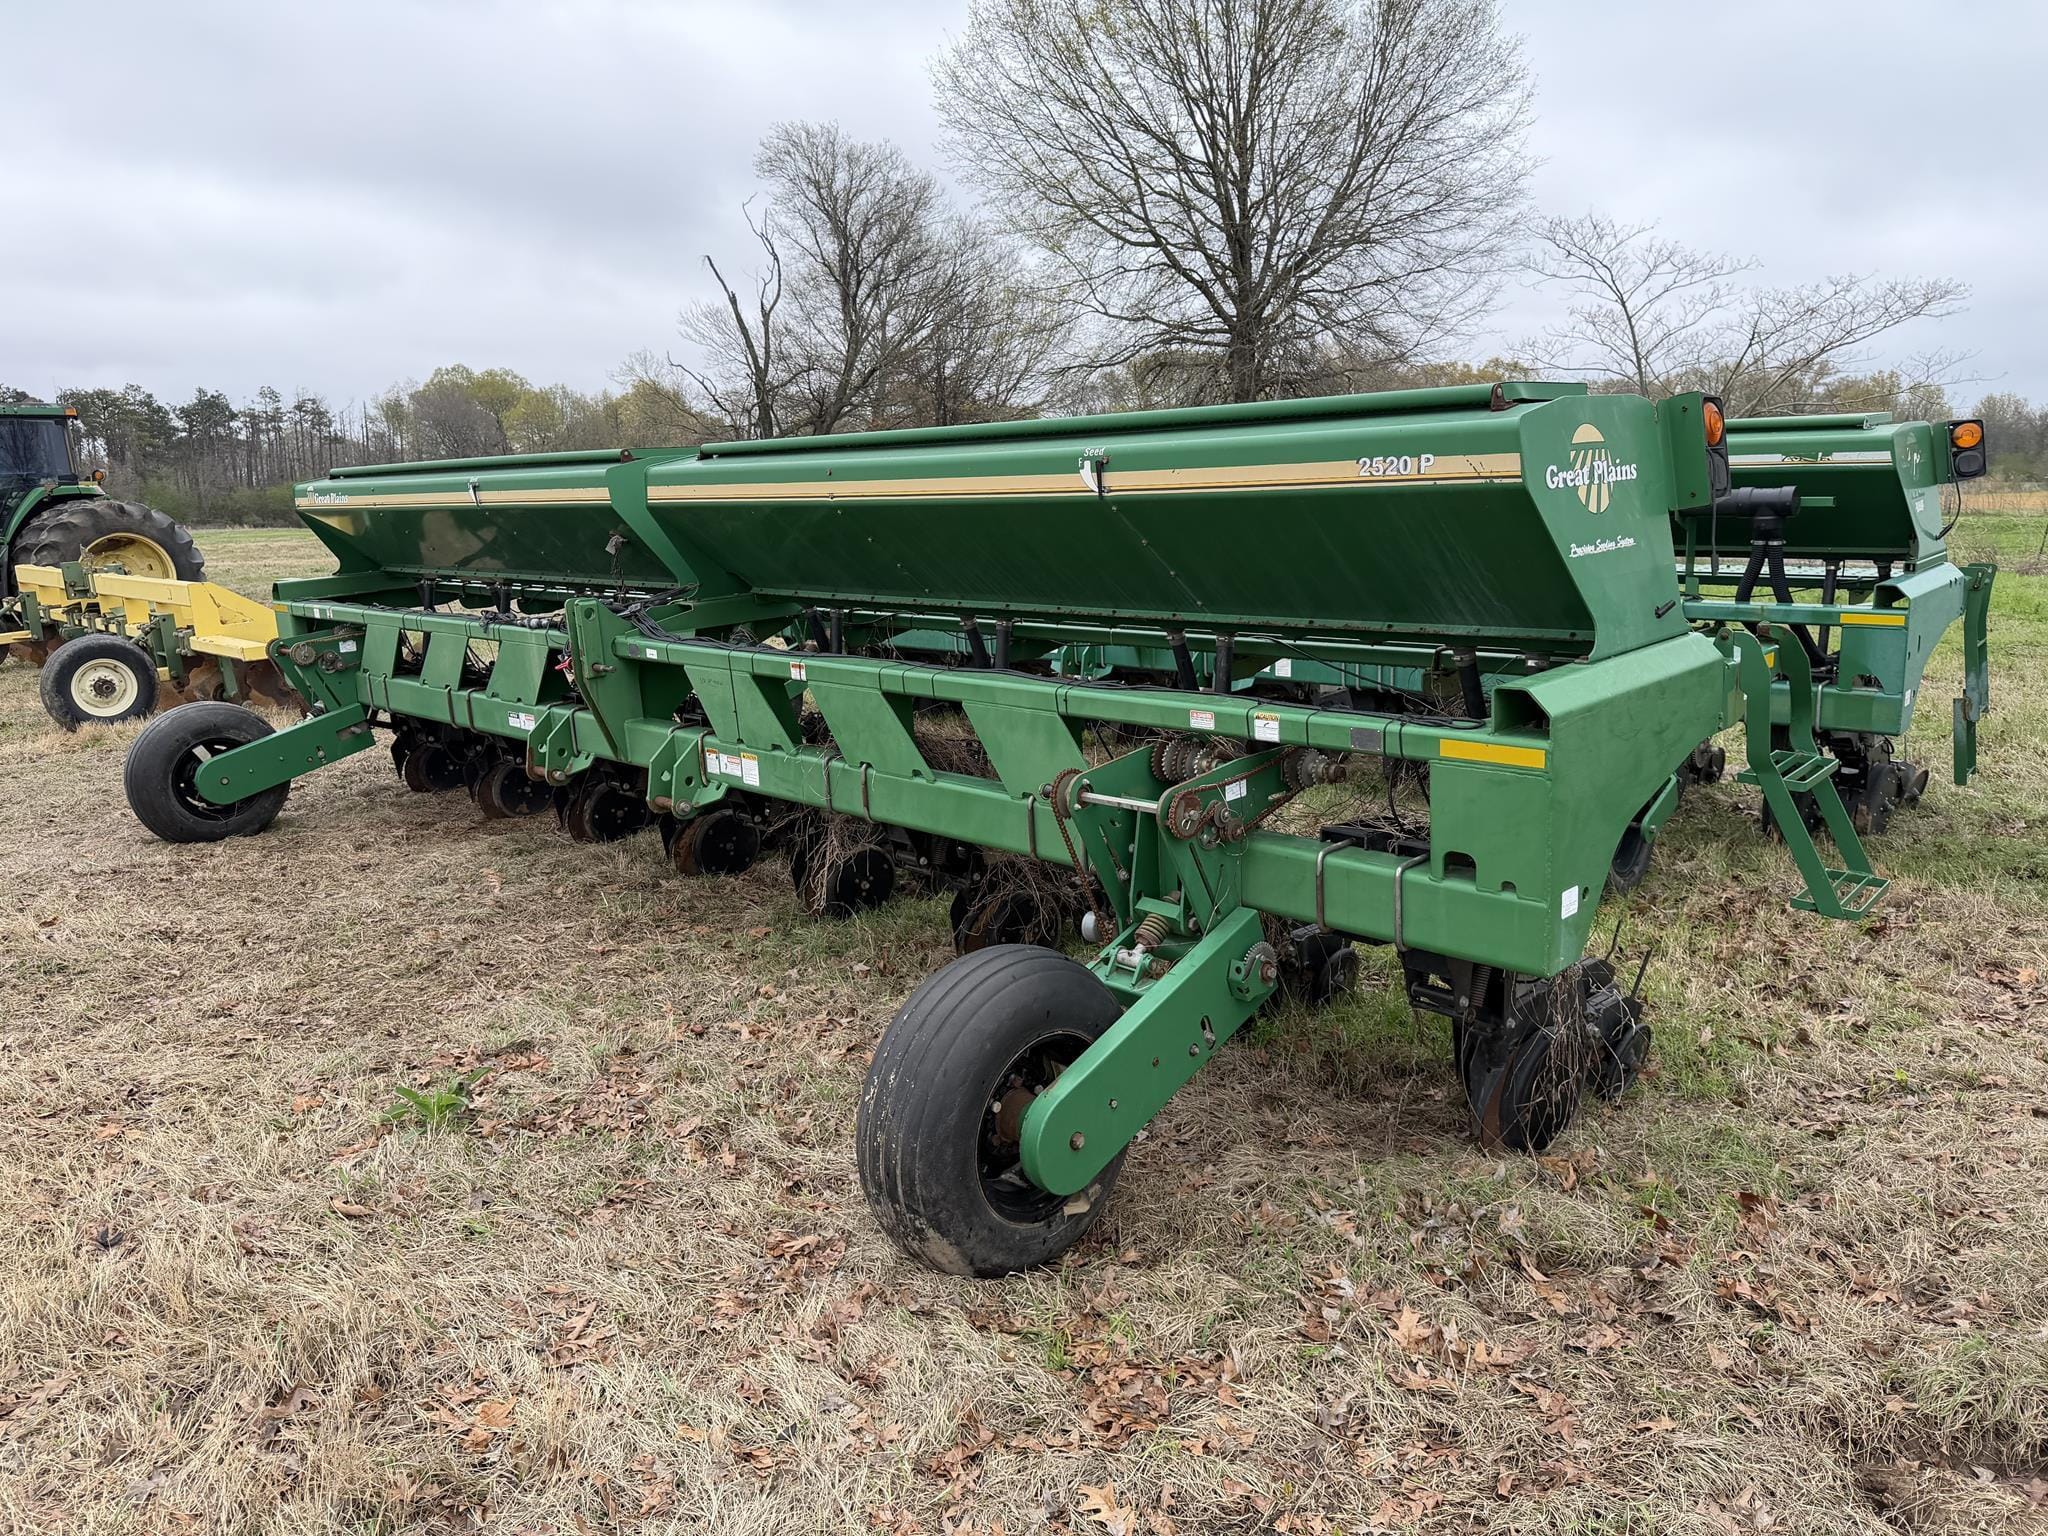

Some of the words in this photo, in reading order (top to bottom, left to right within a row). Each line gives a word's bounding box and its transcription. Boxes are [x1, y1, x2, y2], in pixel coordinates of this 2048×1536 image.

[1084, 447, 1105, 457] Seed
[1357, 455, 1411, 476] 2520
[1418, 453, 1434, 474] P
[1546, 464, 1590, 489] Great
[1593, 458, 1637, 484] Plains
[314, 492, 331, 504] Great
[331, 491, 349, 504] Plains
